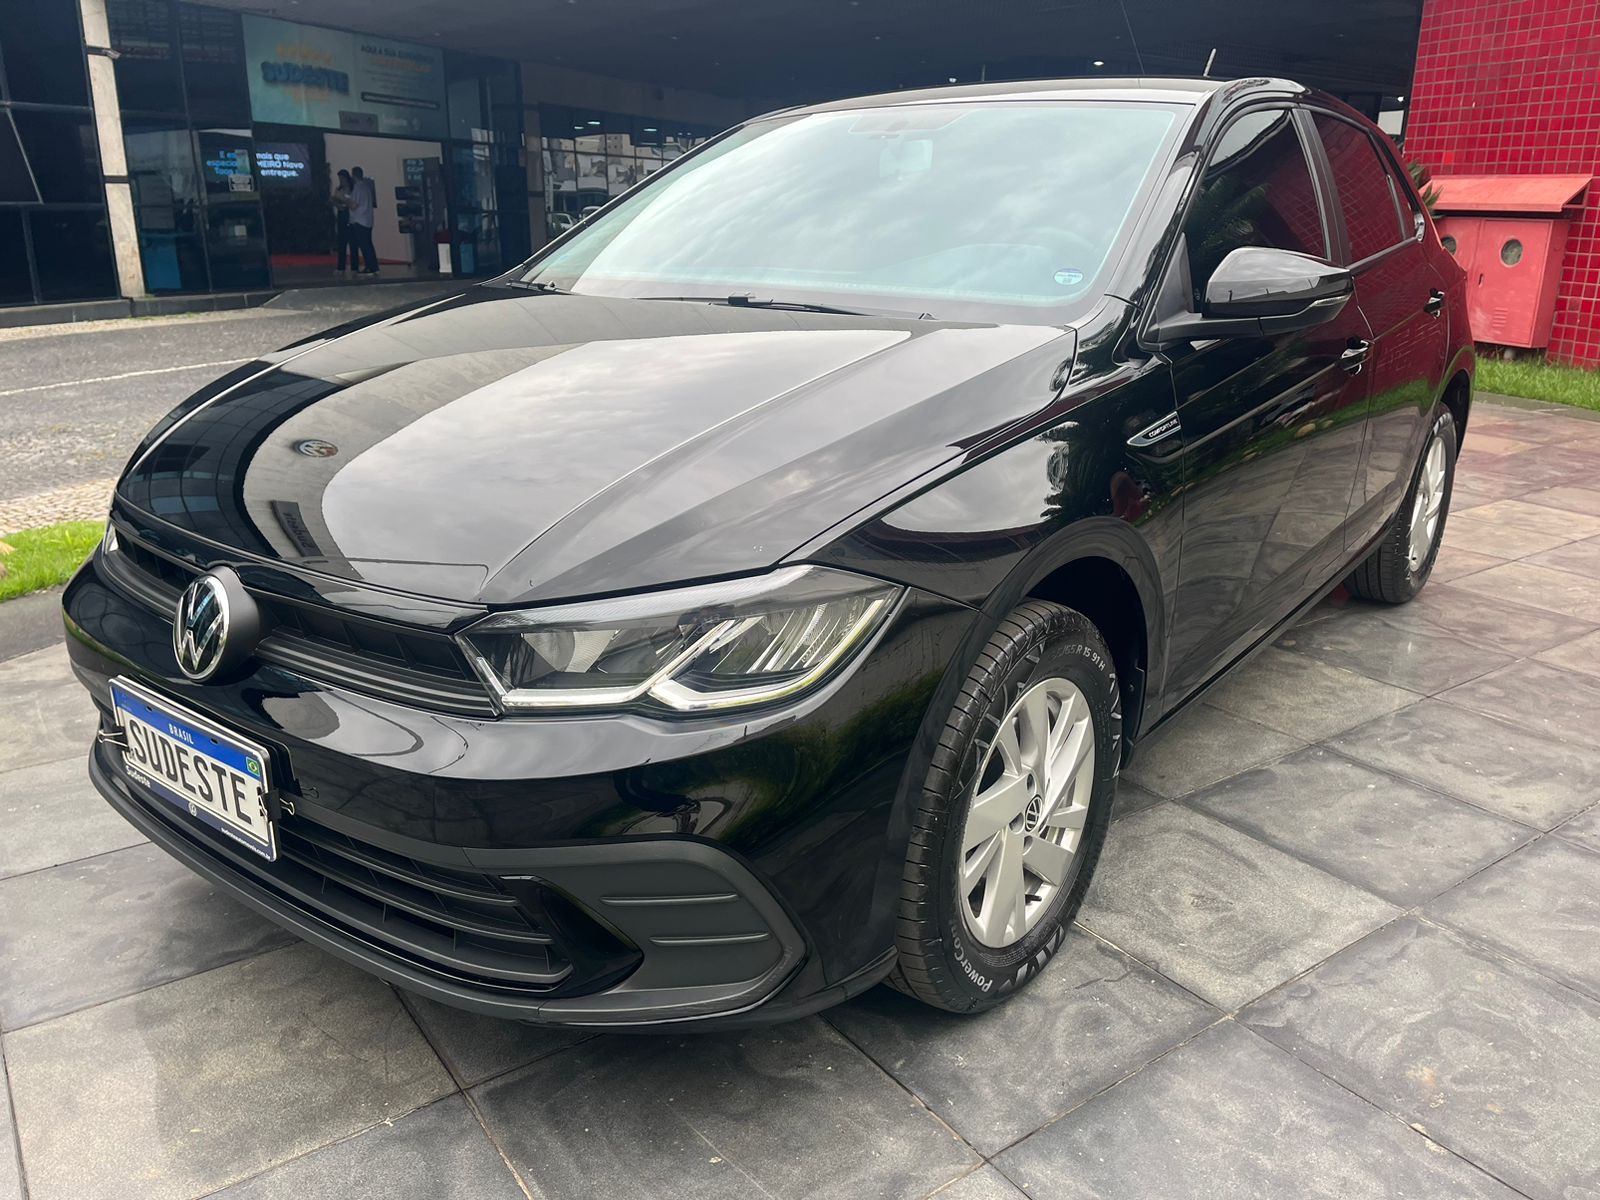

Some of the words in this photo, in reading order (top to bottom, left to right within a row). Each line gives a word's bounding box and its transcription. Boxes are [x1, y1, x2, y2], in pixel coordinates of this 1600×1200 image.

[1083, 646, 1092, 658] 15
[168, 723, 194, 745] BRASIL
[129, 719, 253, 825] SUDESTE
